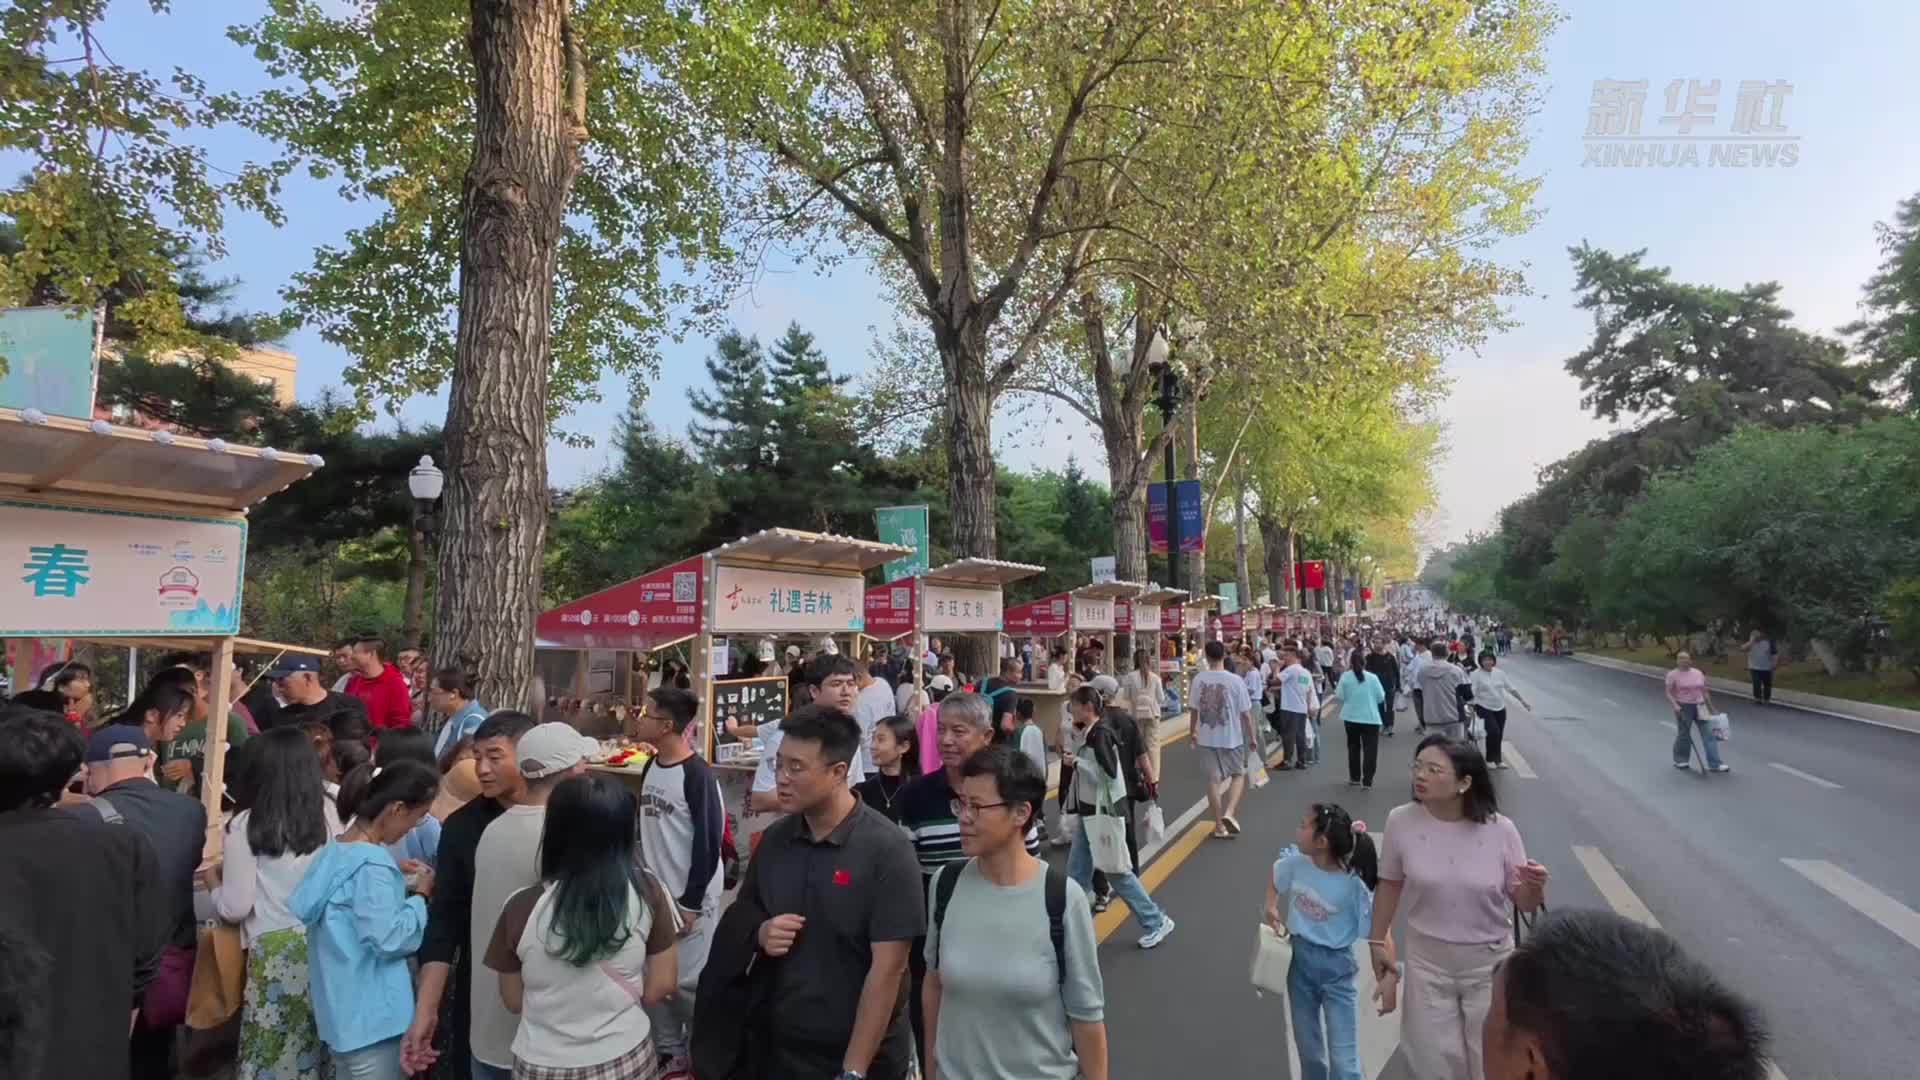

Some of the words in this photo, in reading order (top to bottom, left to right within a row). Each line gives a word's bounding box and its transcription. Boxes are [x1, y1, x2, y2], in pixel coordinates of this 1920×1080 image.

[21, 544, 90, 597] 春
[769, 587, 833, 615] 礼遇吉林
